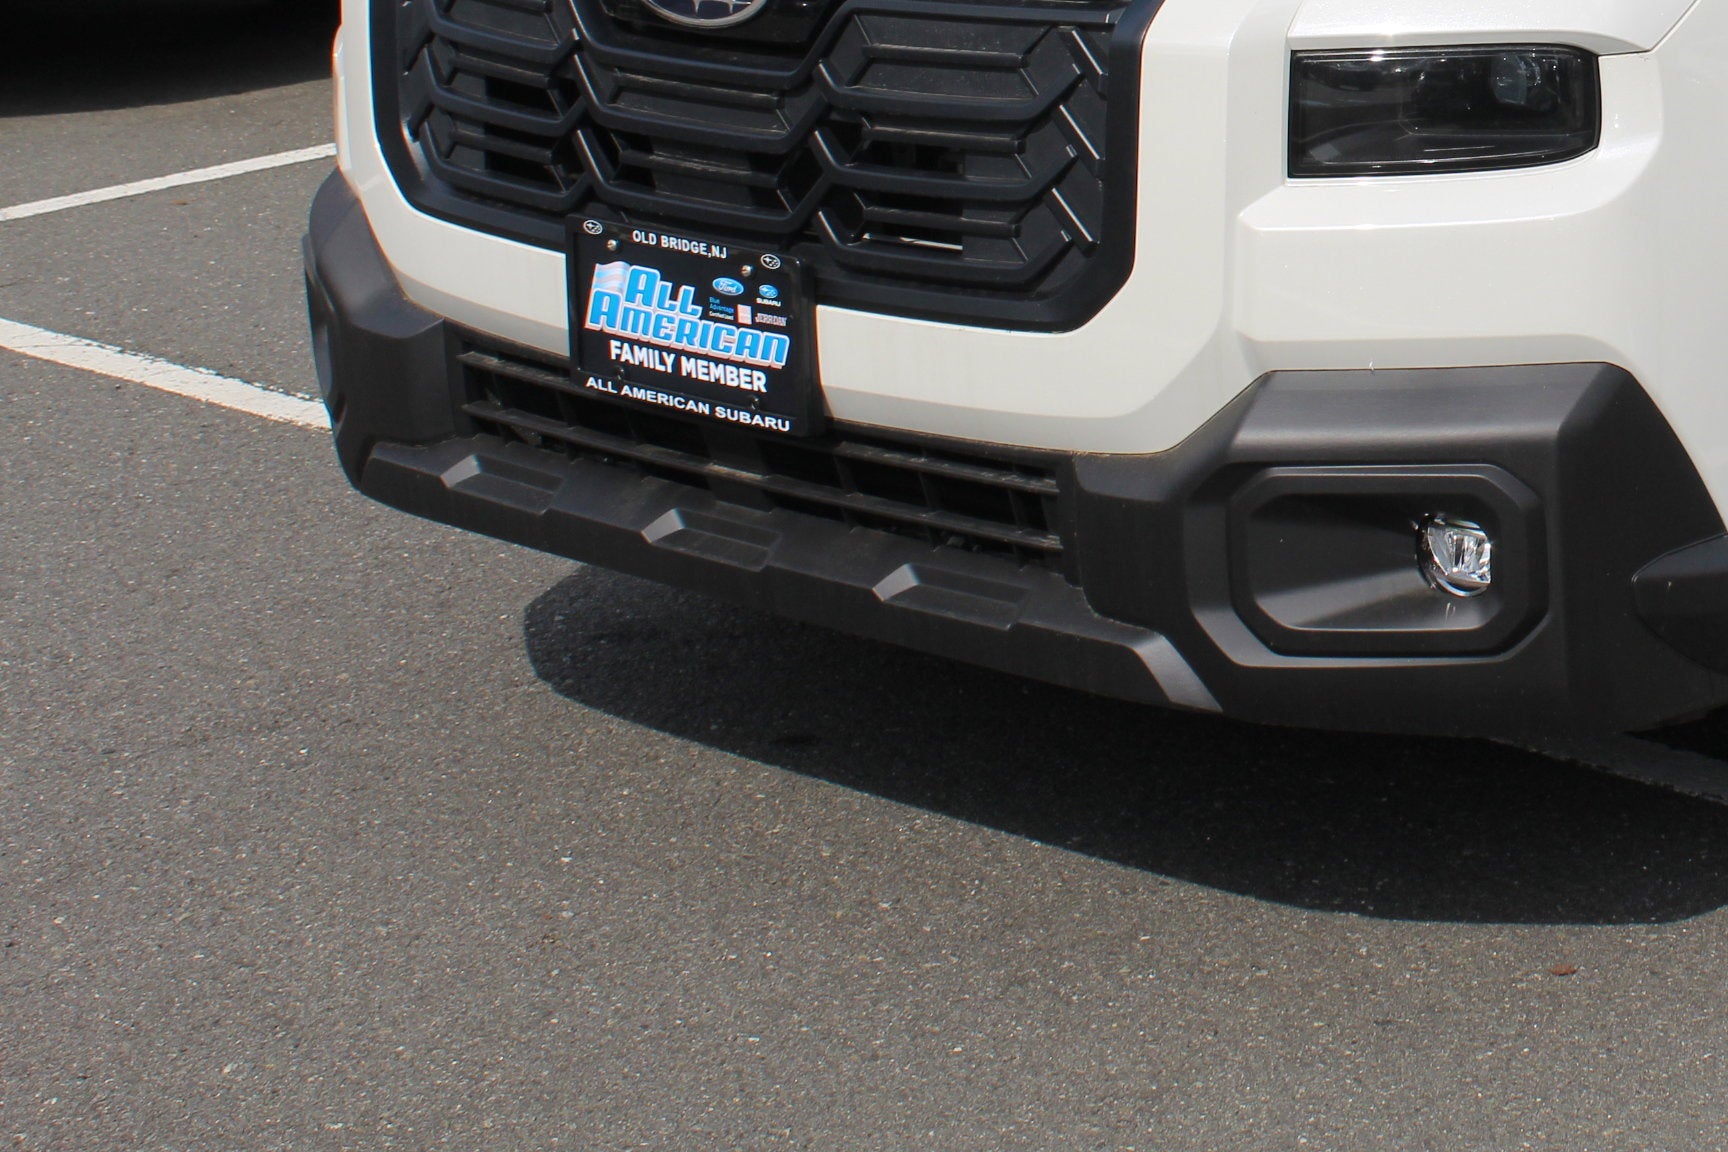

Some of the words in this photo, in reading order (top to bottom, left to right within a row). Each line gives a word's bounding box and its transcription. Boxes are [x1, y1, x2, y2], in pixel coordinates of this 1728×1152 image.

[632, 230, 656, 245] OLD
[609, 339, 676, 374] FAMILY
[681, 356, 767, 393] MEMBER
[585, 376, 617, 394] ALL
[620, 384, 710, 415] AMERICAN
[715, 406, 790, 432] SUBARU
